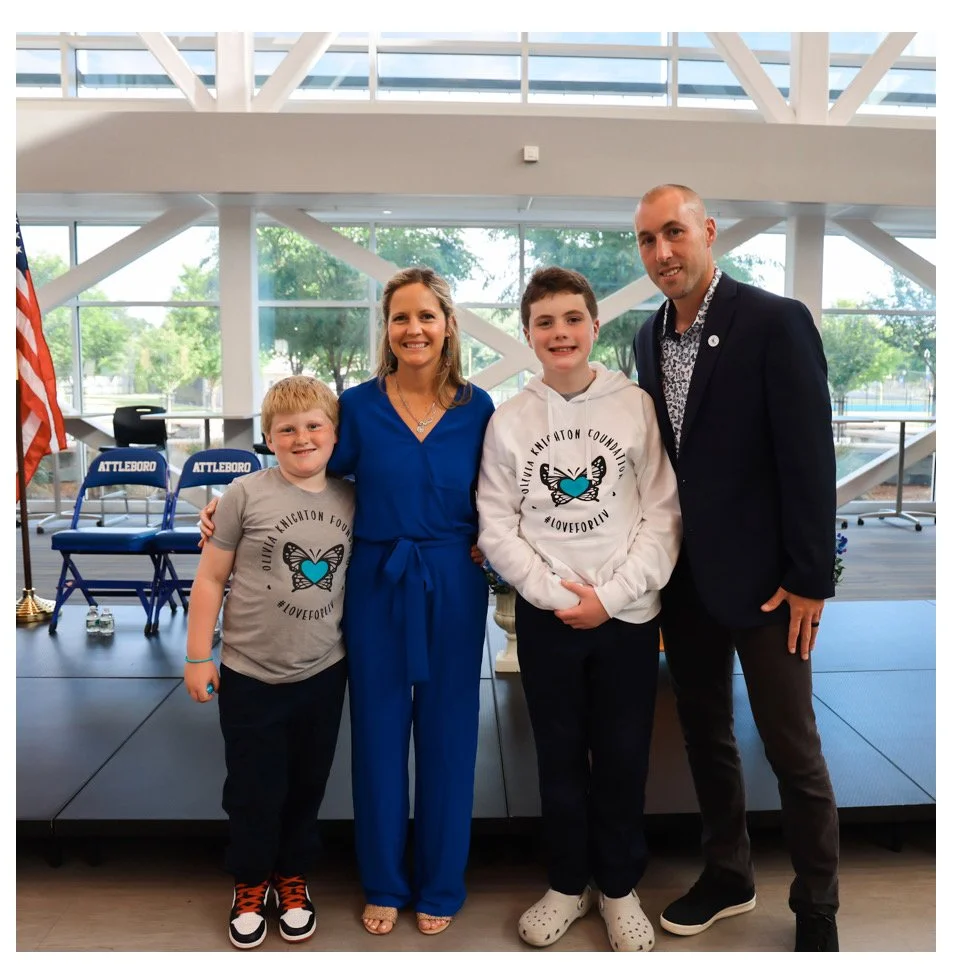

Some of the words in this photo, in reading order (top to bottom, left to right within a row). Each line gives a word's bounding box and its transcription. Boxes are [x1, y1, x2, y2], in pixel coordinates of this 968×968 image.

[98, 461, 157, 472] ATTLEBORO
[192, 462, 252, 473] ATTLEBORO
[544, 509, 610, 534] #LOVEFORLIV
[261, 535, 278, 572] OLIVIA
[275, 509, 324, 534] KNIGHTON
